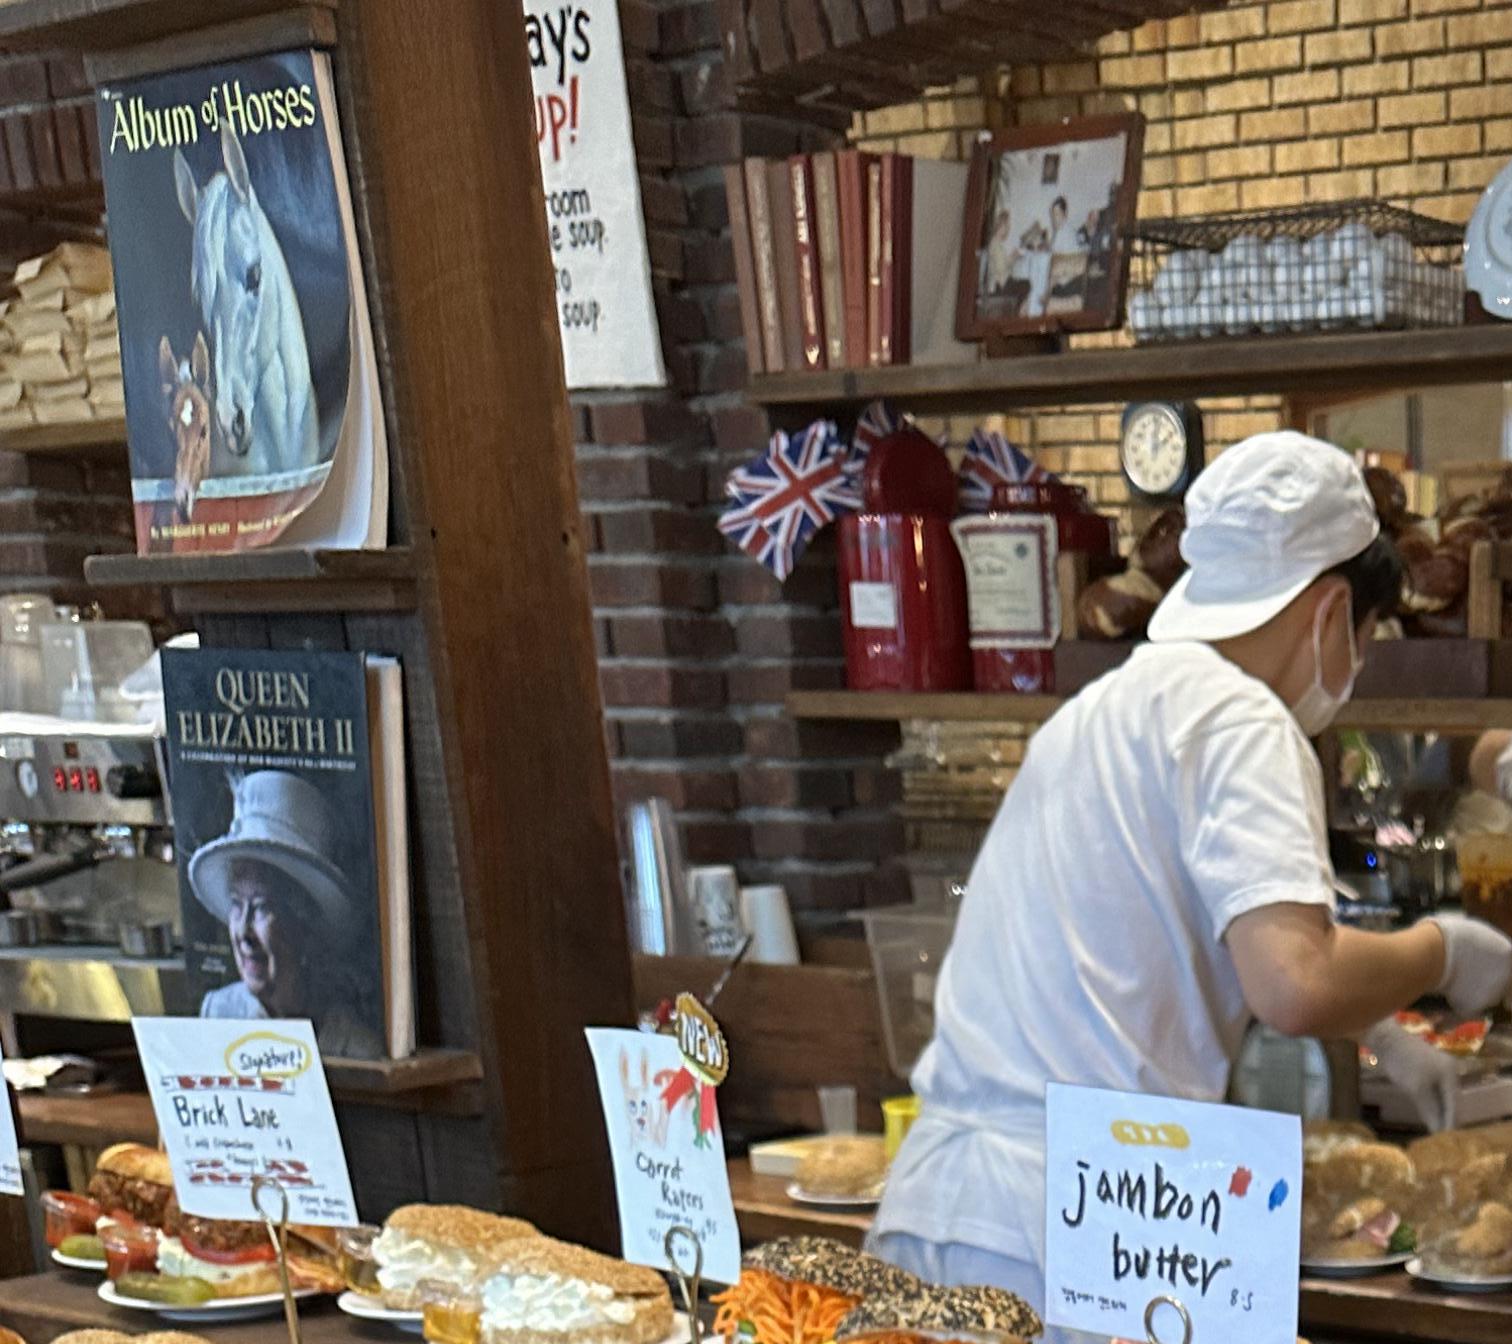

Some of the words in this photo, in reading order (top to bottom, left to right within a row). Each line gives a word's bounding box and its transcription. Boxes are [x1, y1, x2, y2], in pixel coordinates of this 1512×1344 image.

[110, 96, 198, 155] Album
[201, 85, 219, 132] of
[221, 79, 316, 136] Horses
[546, 188, 592, 218] oom
[215, 667, 310, 715] QUEEN
[176, 709, 326, 755] ELIZABETH
[334, 718, 354, 756] II
[172, 1094, 229, 1129] Brick
[236, 1095, 281, 1130] Lane
[1062, 1159, 1222, 1235] jambon
[1112, 1231, 1233, 1297] butter
